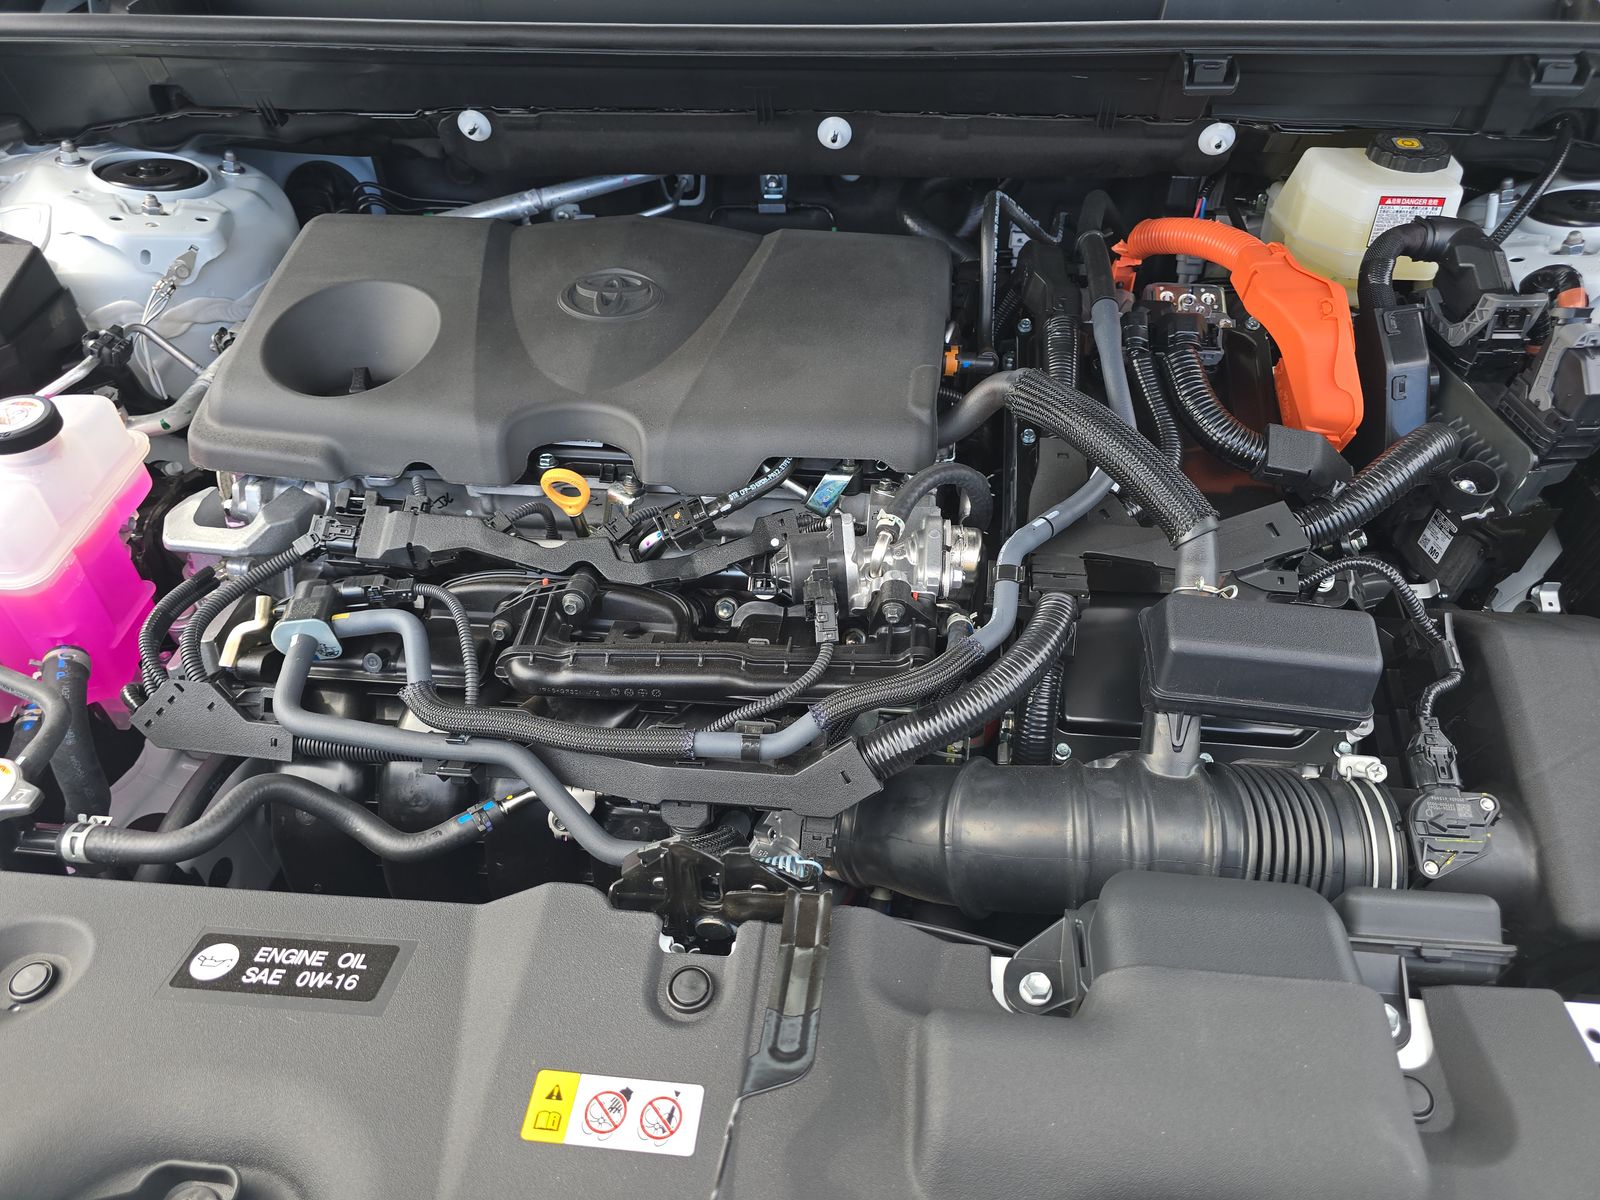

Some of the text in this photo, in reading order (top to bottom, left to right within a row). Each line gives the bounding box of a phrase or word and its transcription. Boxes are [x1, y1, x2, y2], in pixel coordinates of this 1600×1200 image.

[1401, 198, 1427, 206] DANGER
[1427, 545, 1440, 560] M9
[254, 946, 368, 970] ENGINE OIL
[241, 966, 360, 991] SAE 0W-16
